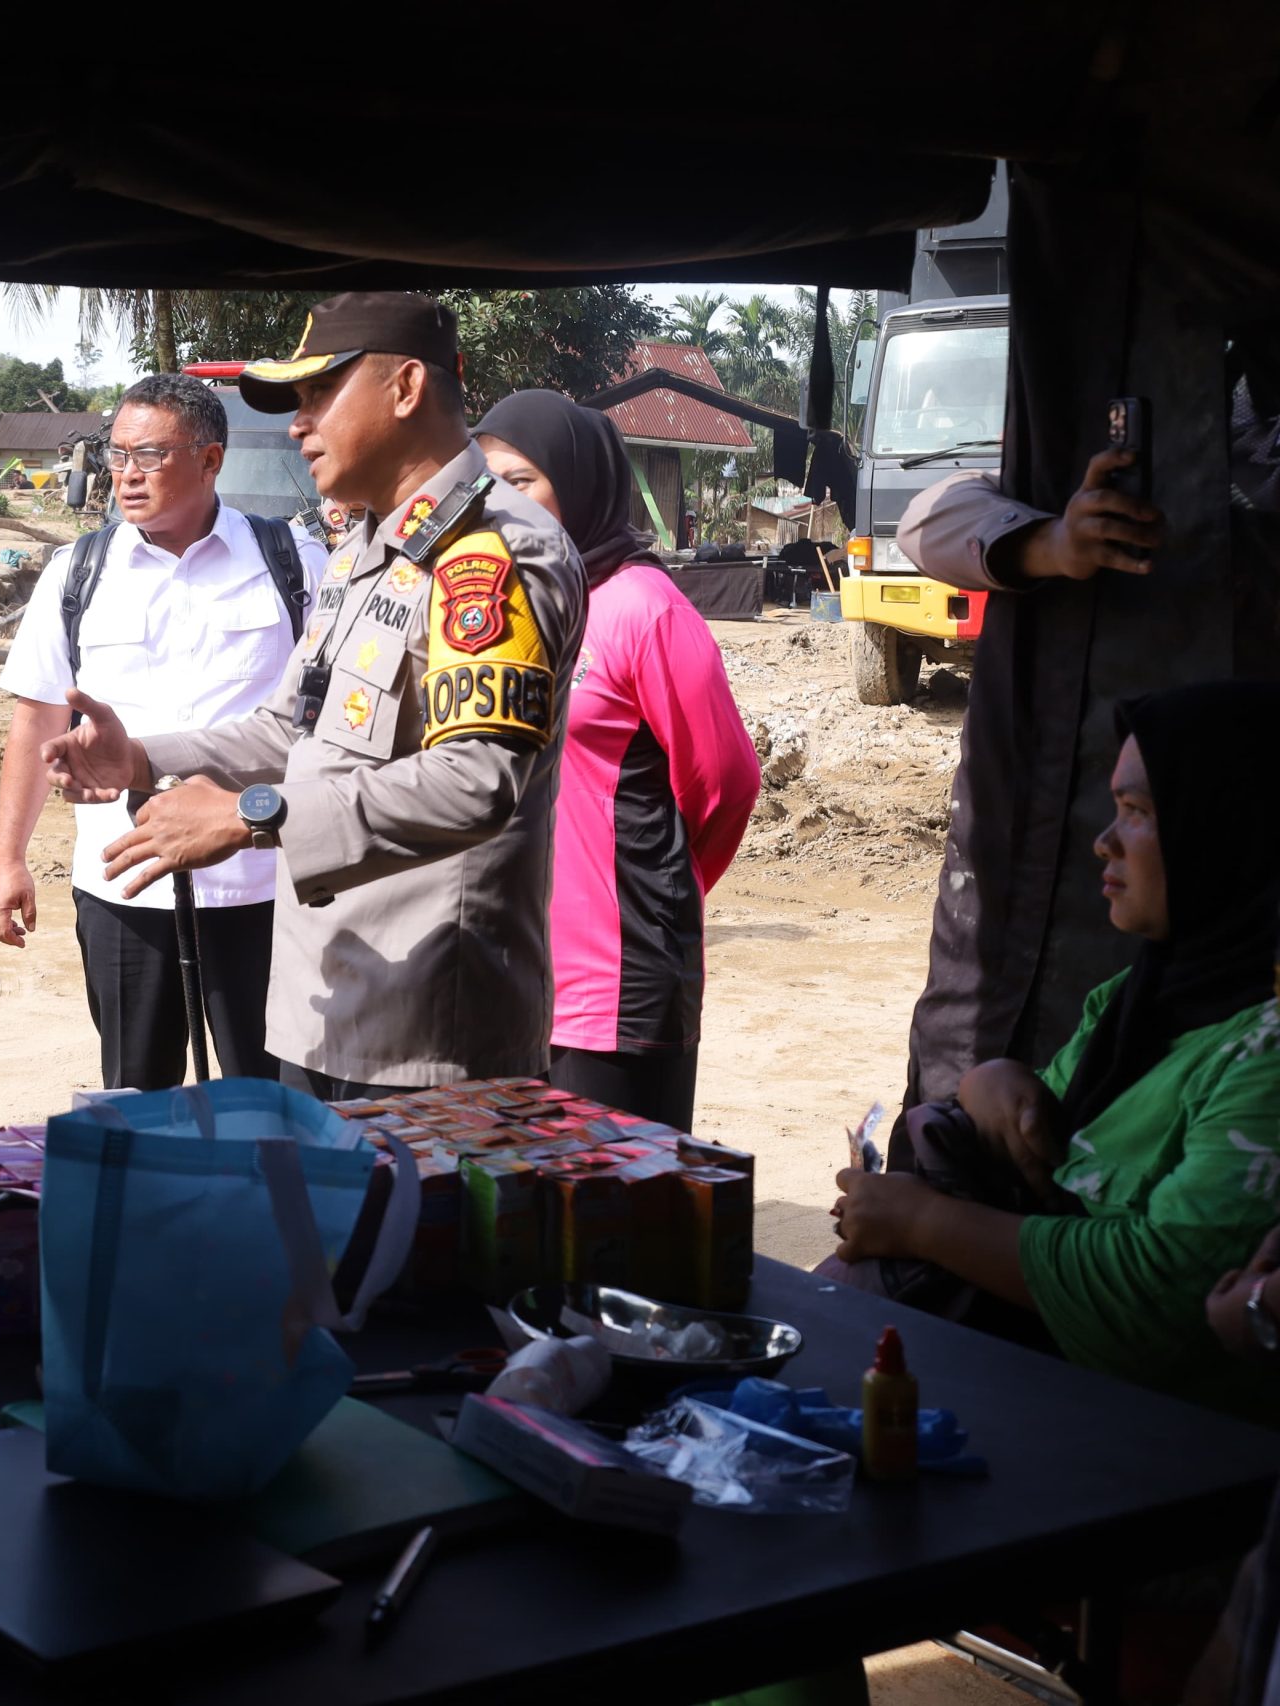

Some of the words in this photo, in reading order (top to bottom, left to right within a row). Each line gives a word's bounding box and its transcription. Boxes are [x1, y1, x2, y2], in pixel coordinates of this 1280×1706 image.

[446, 560, 497, 577] POLRES
[365, 593, 411, 631] POLRI
[433, 665, 496, 725] OPS
